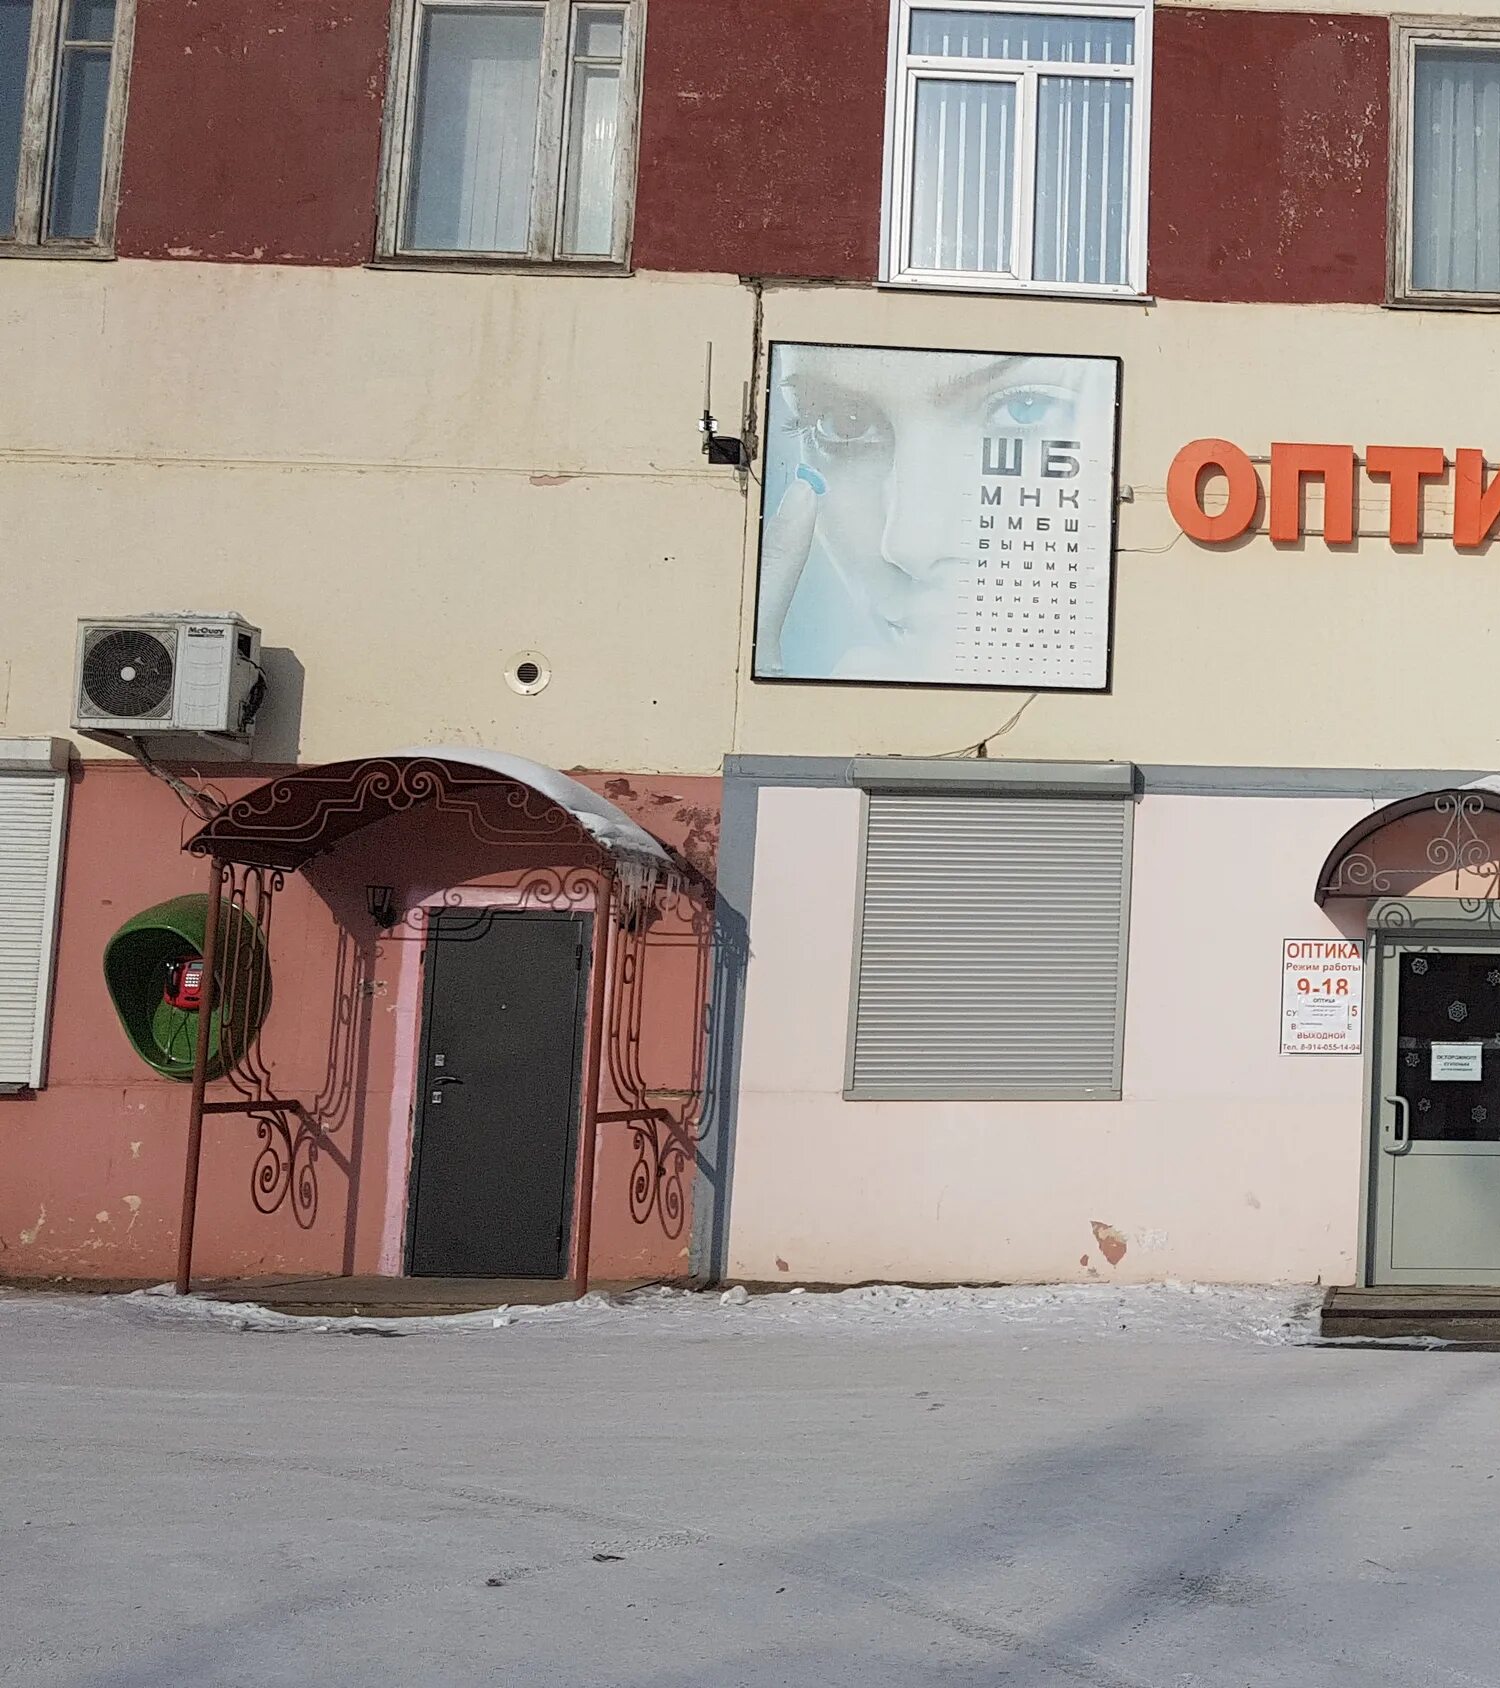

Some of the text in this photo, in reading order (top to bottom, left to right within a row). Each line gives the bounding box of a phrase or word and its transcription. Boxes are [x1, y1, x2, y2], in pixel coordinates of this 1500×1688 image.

[1287, 943, 1360, 959] ОПТИКА
[1286, 962, 1361, 973] Режим работы
[1297, 978, 1349, 995] 9-18
[1297, 1031, 1346, 1040] ВЫХОДНОЙ
